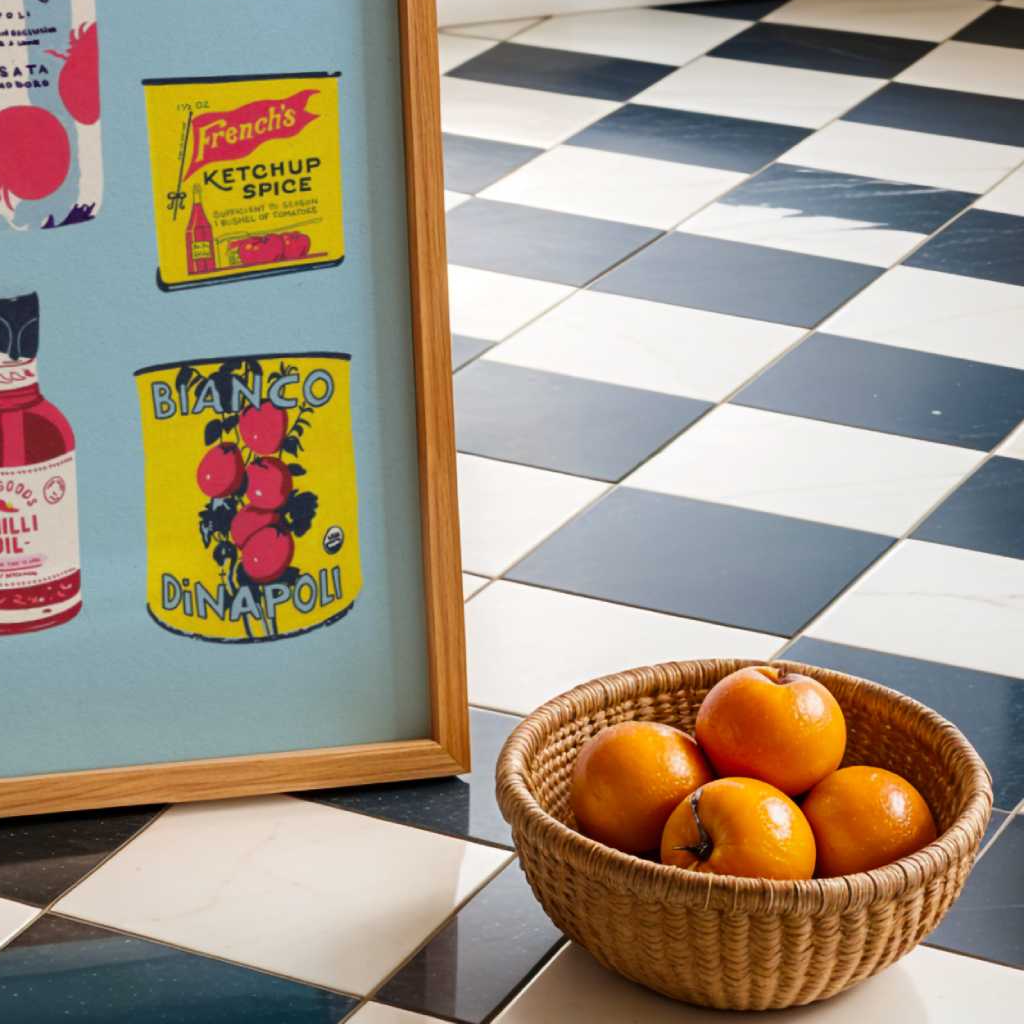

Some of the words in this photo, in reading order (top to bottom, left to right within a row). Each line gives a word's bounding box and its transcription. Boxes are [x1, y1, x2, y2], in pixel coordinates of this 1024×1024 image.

[197, 103, 296, 162] French's
[203, 156, 321, 192] KETCHUP
[242, 176, 312, 199] SPICE
[151, 368, 335, 420] BIANCO
